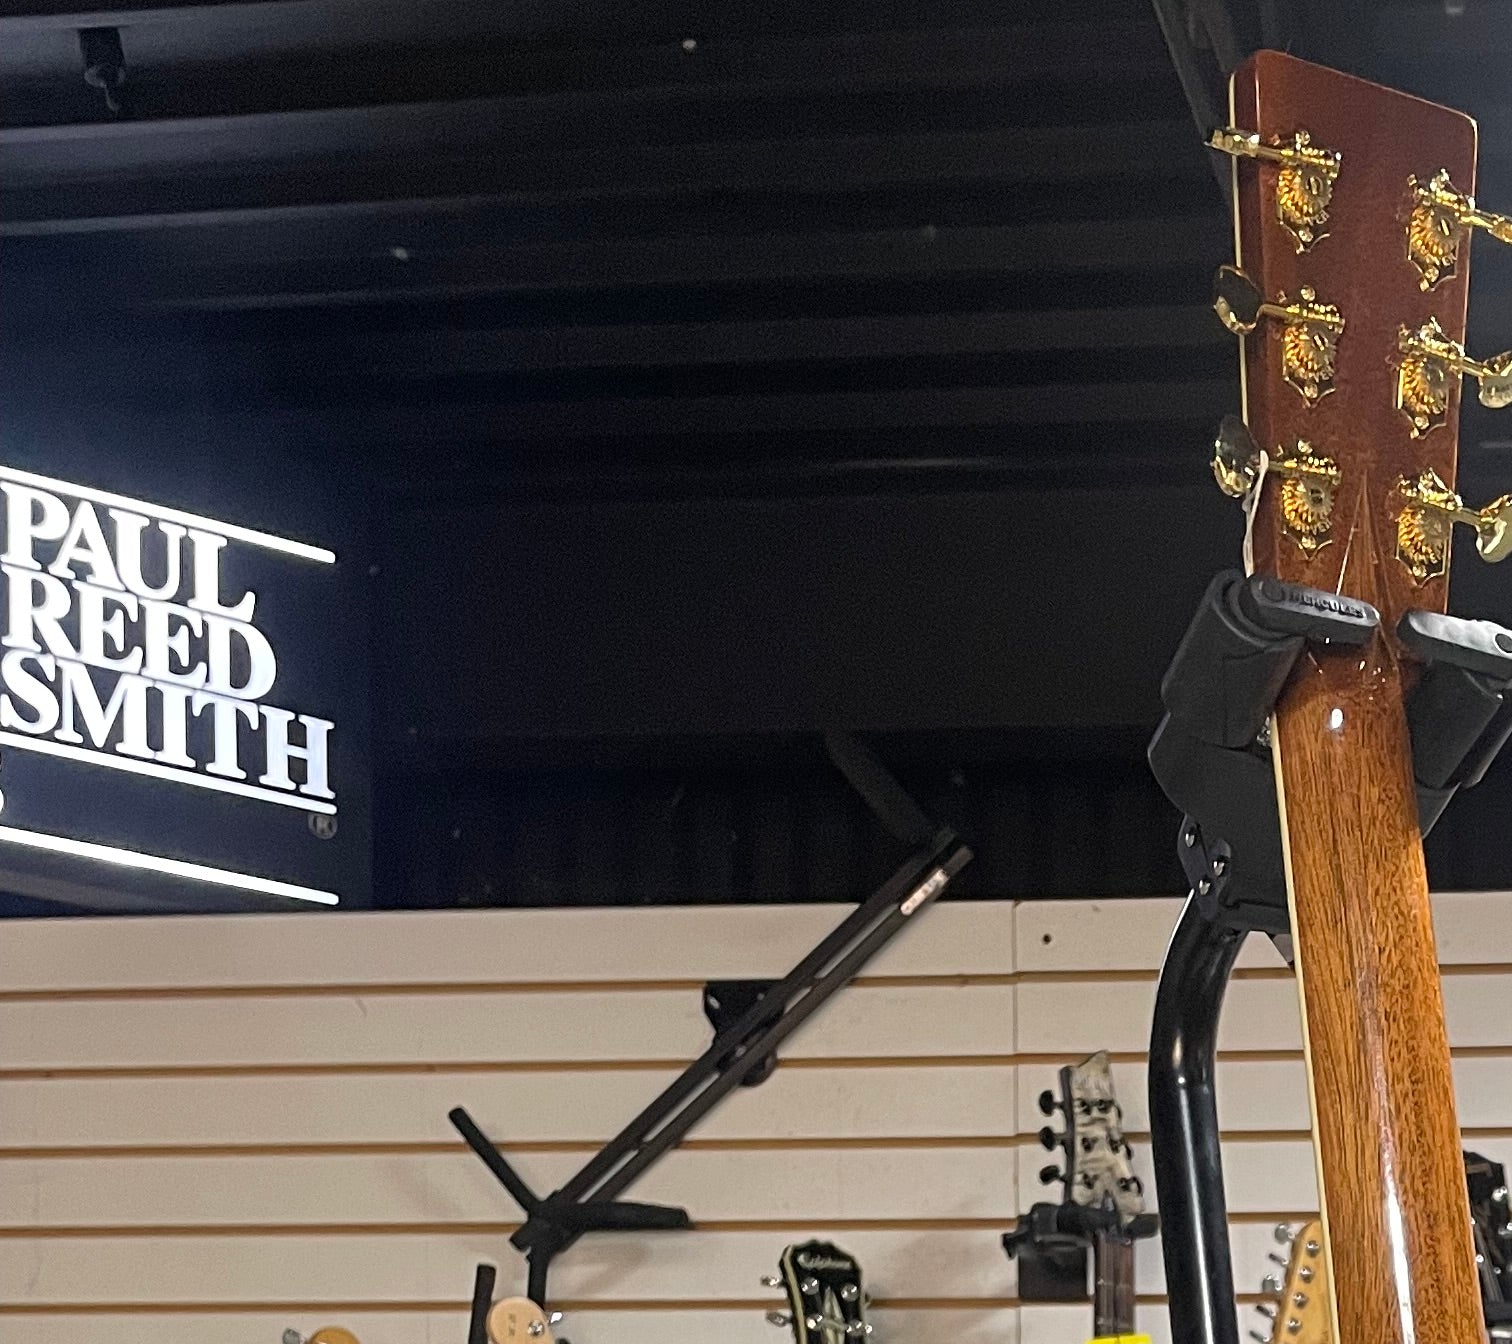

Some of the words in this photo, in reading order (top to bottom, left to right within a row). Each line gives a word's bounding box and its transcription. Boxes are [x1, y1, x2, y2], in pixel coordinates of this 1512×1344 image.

[0, 481, 256, 622] PAUL
[1, 564, 277, 700] REED
[0, 648, 335, 799] SMITH
